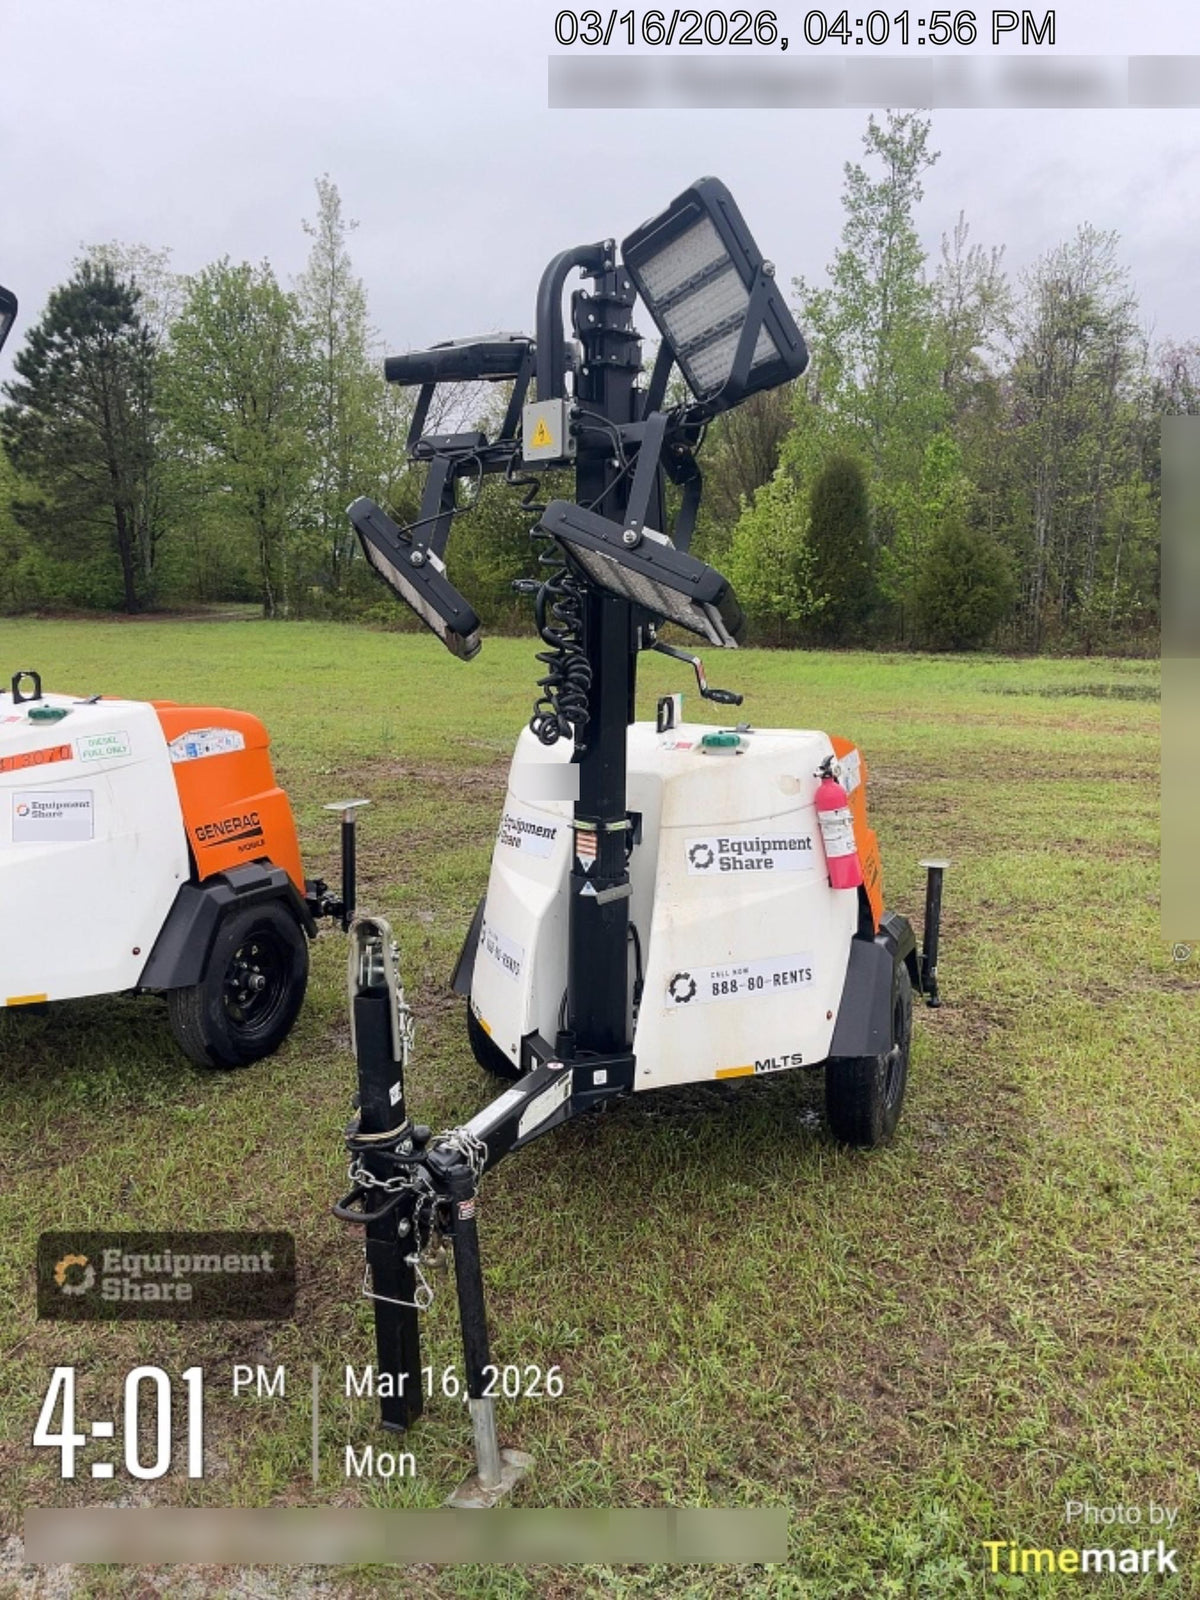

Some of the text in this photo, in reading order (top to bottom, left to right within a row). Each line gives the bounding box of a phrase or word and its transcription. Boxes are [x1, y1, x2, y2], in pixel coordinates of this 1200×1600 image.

[31, 801, 91, 811] Equipment
[31, 810, 63, 819] Share
[195, 812, 260, 841] GENERAC
[717, 836, 812, 855] Equipment
[719, 856, 774, 871] Share
[711, 967, 749, 979] CALL NOW
[755, 1053, 803, 1072] MLTS
